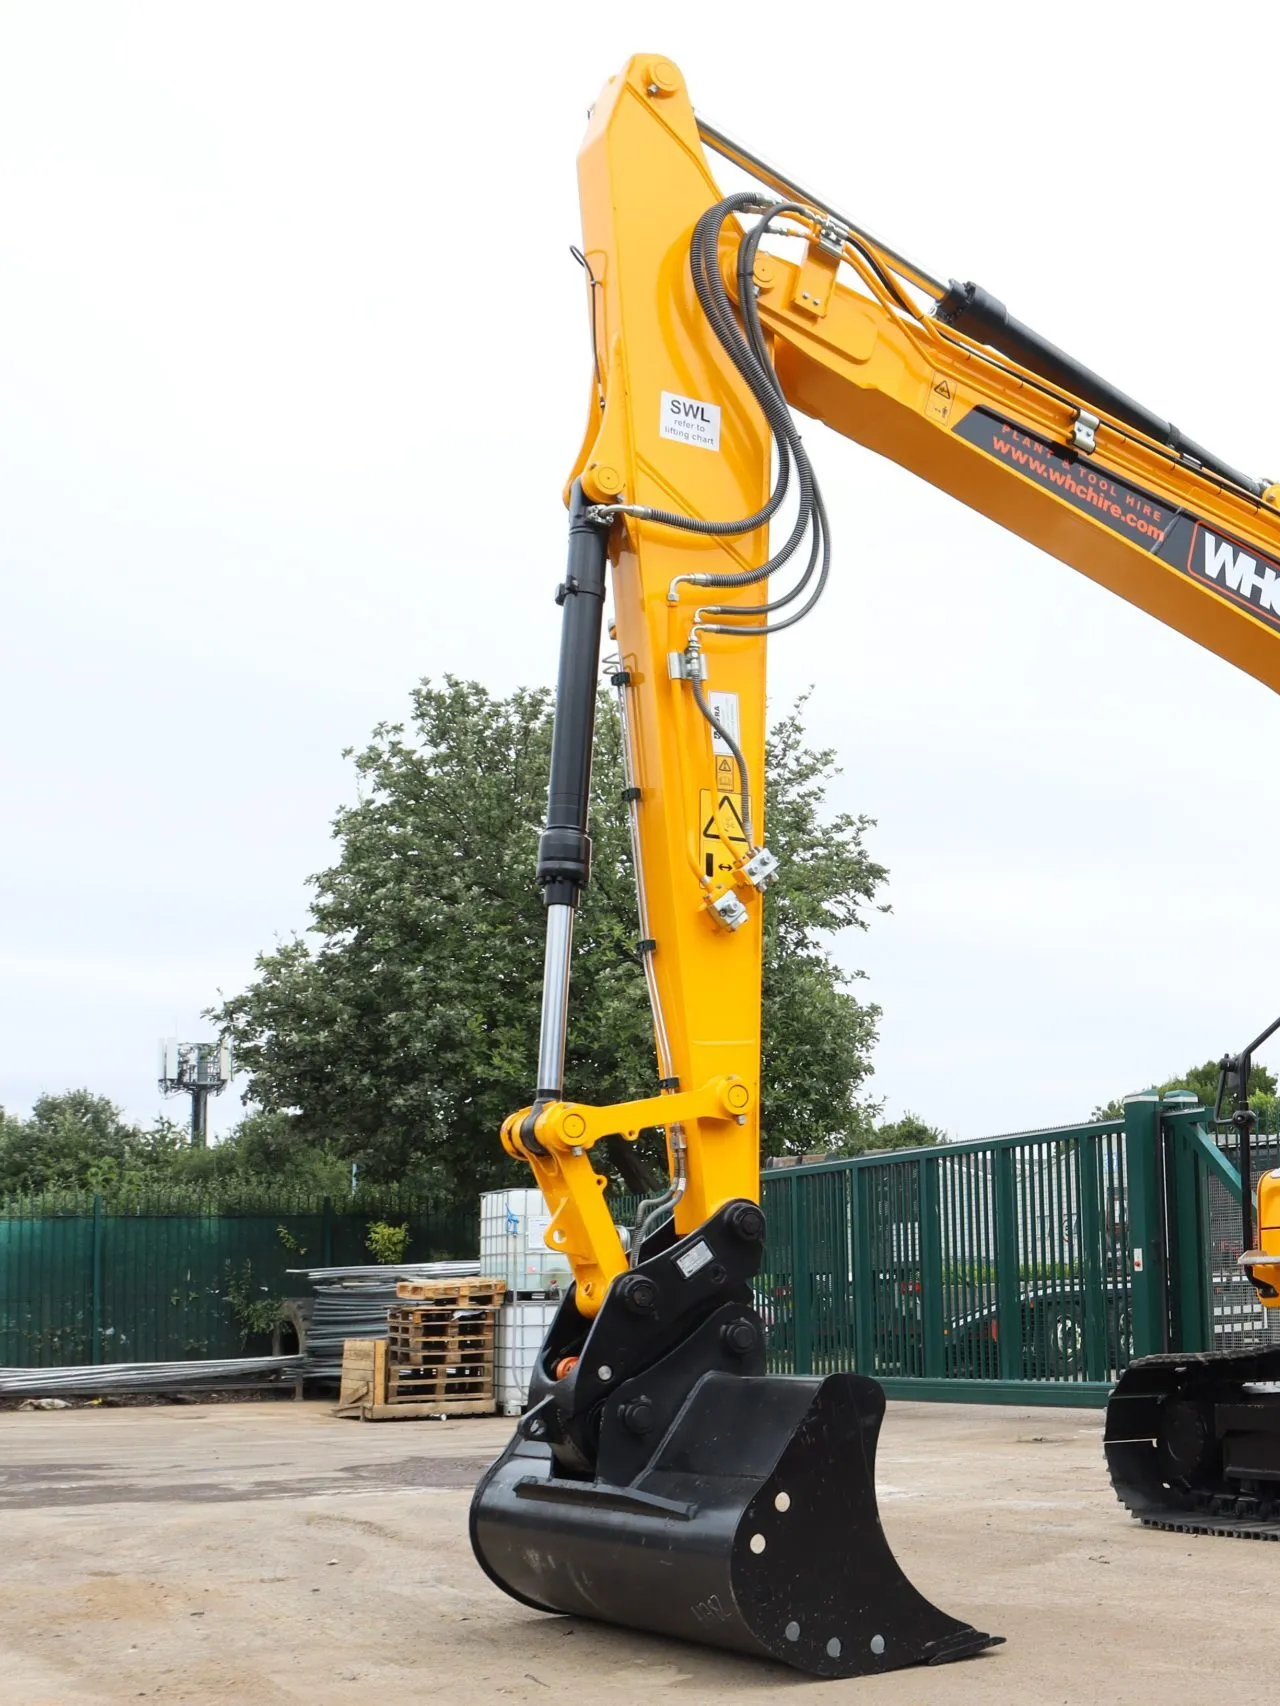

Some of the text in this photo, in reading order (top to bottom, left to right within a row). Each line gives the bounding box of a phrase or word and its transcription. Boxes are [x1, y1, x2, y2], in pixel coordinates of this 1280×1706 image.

[670, 399, 711, 423] SWL
[664, 425, 714, 445] lifting chart
[674, 419, 706, 433] refer to
[1002, 423, 1162, 522] PLANT & TOOL HIRE
[992, 435, 1166, 542] www.whchire.com
